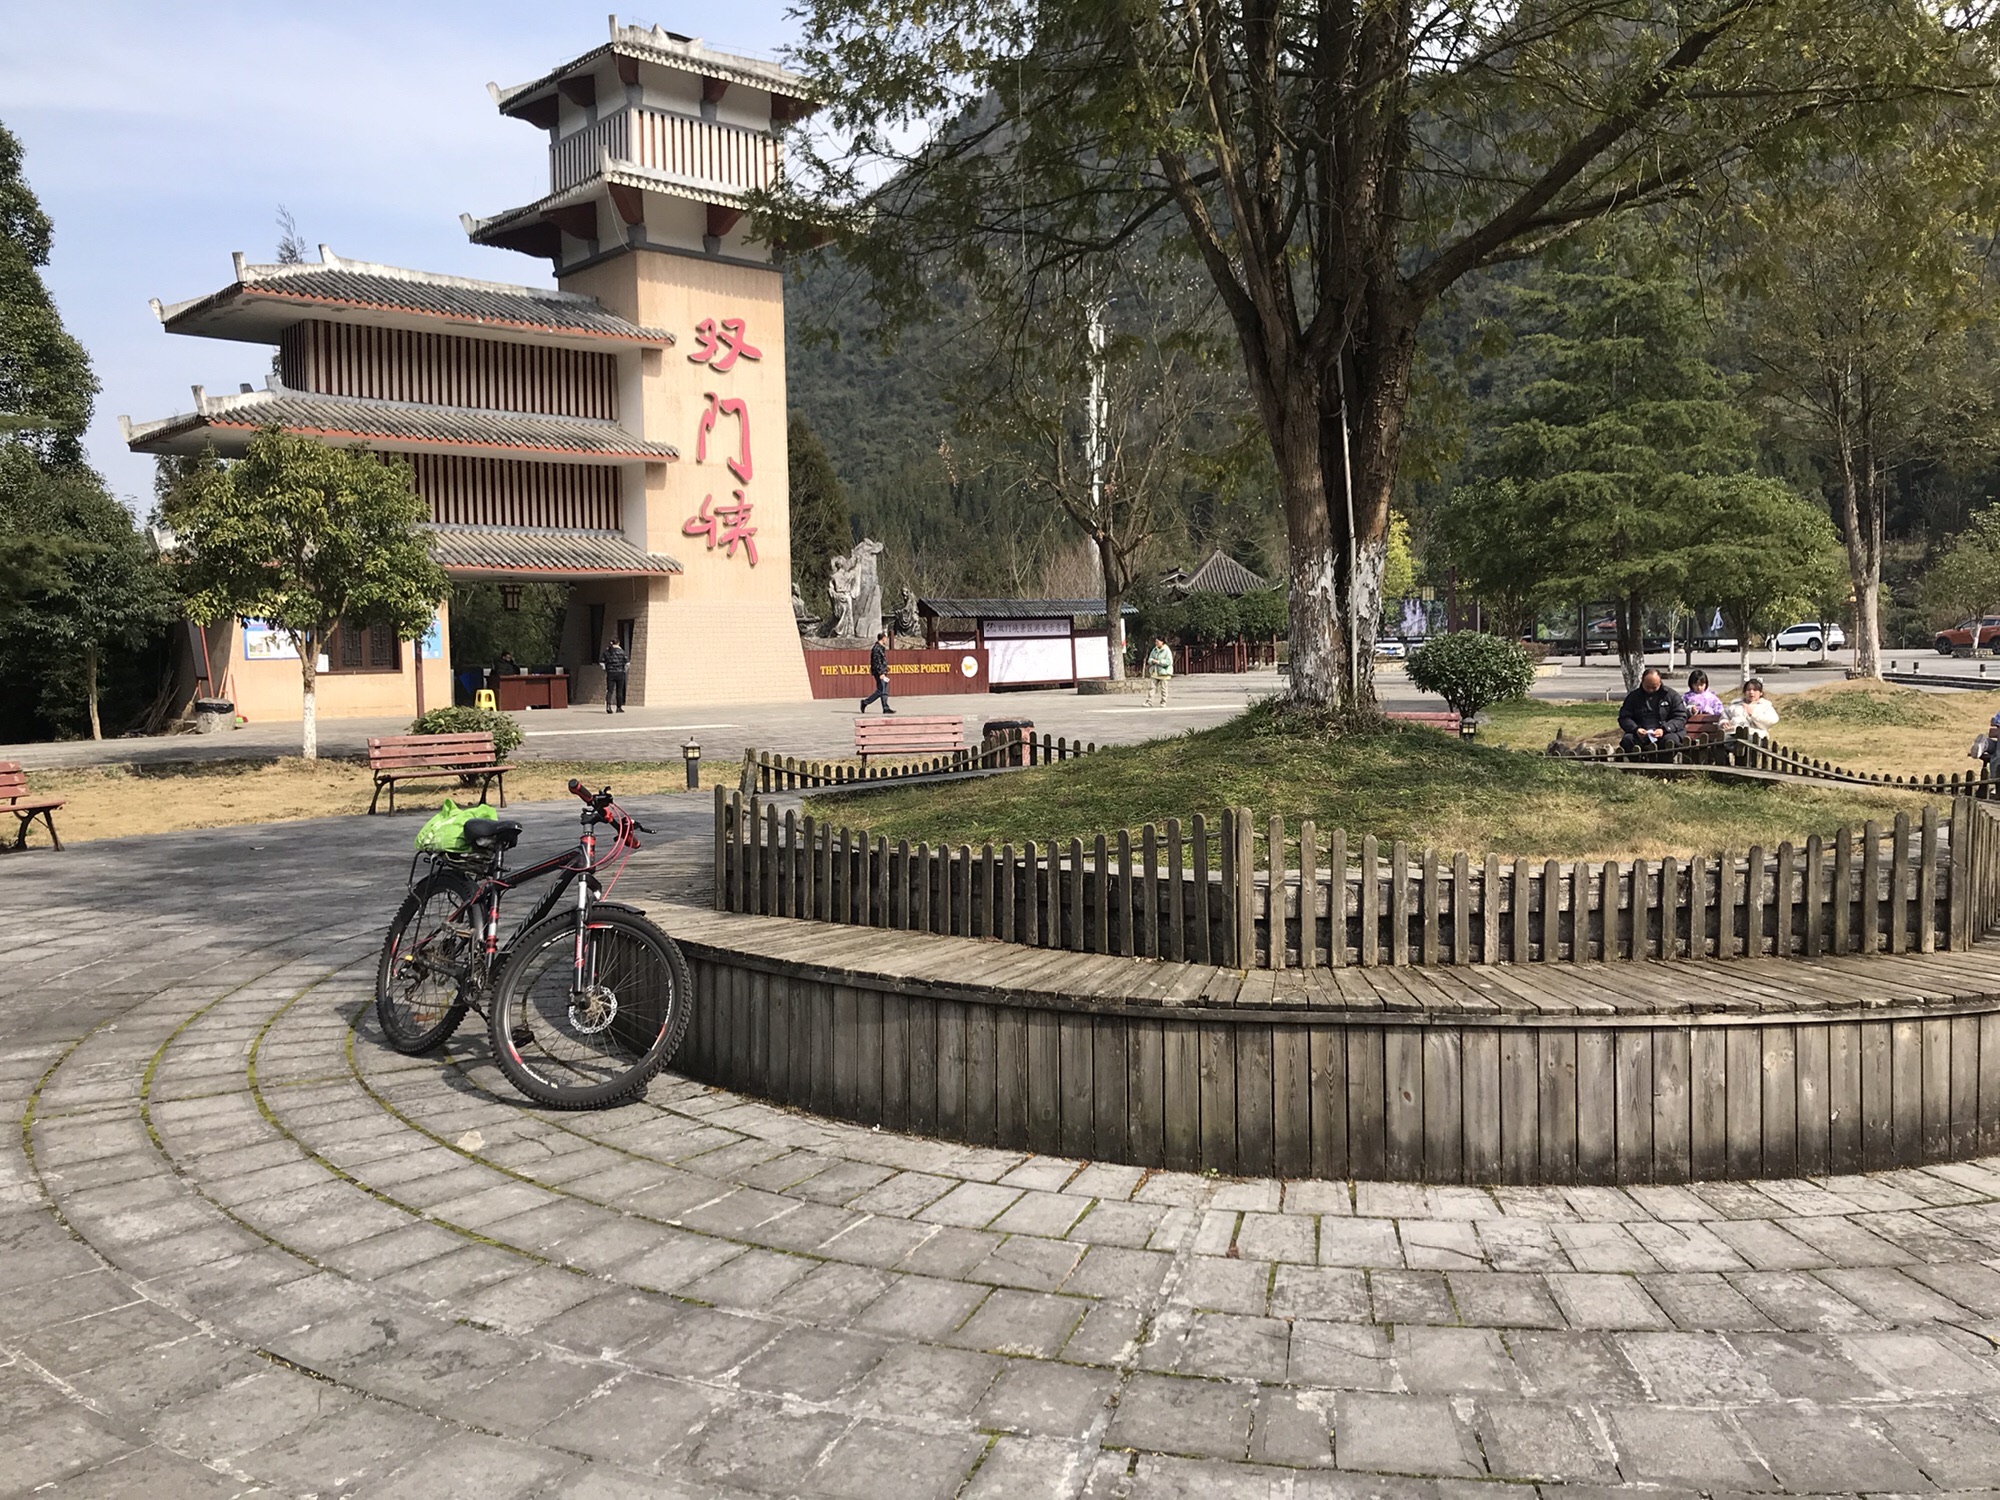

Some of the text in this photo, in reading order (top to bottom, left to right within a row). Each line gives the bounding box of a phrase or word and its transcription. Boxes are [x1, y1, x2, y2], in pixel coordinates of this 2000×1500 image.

[682, 318, 763, 567] 双门峡
[820, 665, 838, 676] THE
[839, 664, 871, 676] VALLEY
[920, 662, 951, 674] POETRY
